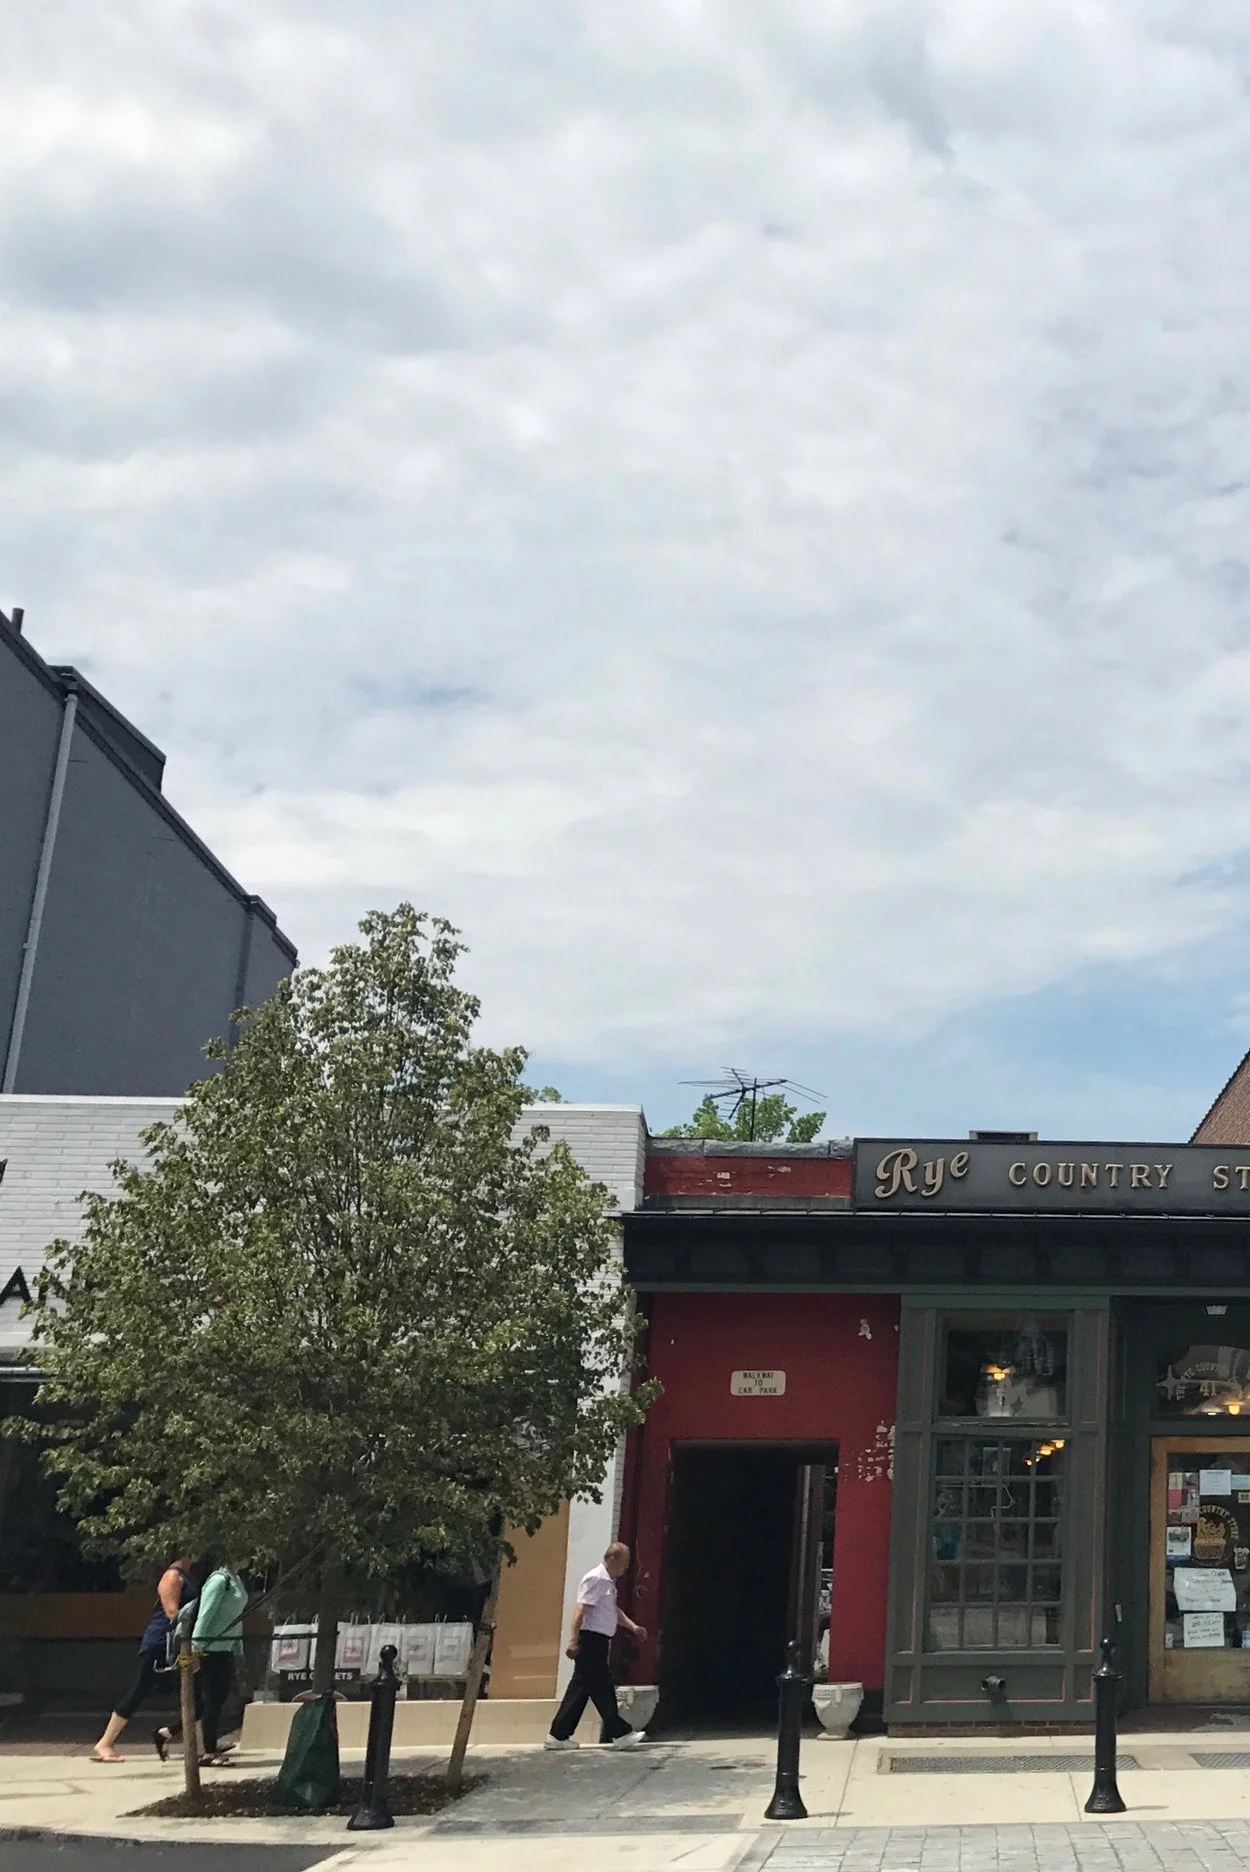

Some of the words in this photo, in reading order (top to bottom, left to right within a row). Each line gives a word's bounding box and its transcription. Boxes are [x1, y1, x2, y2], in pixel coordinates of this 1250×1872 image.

[874, 1148, 969, 1199] Rye
[1008, 1162, 1173, 1189] COUNTRY
[287, 1672, 307, 1680] RYE
